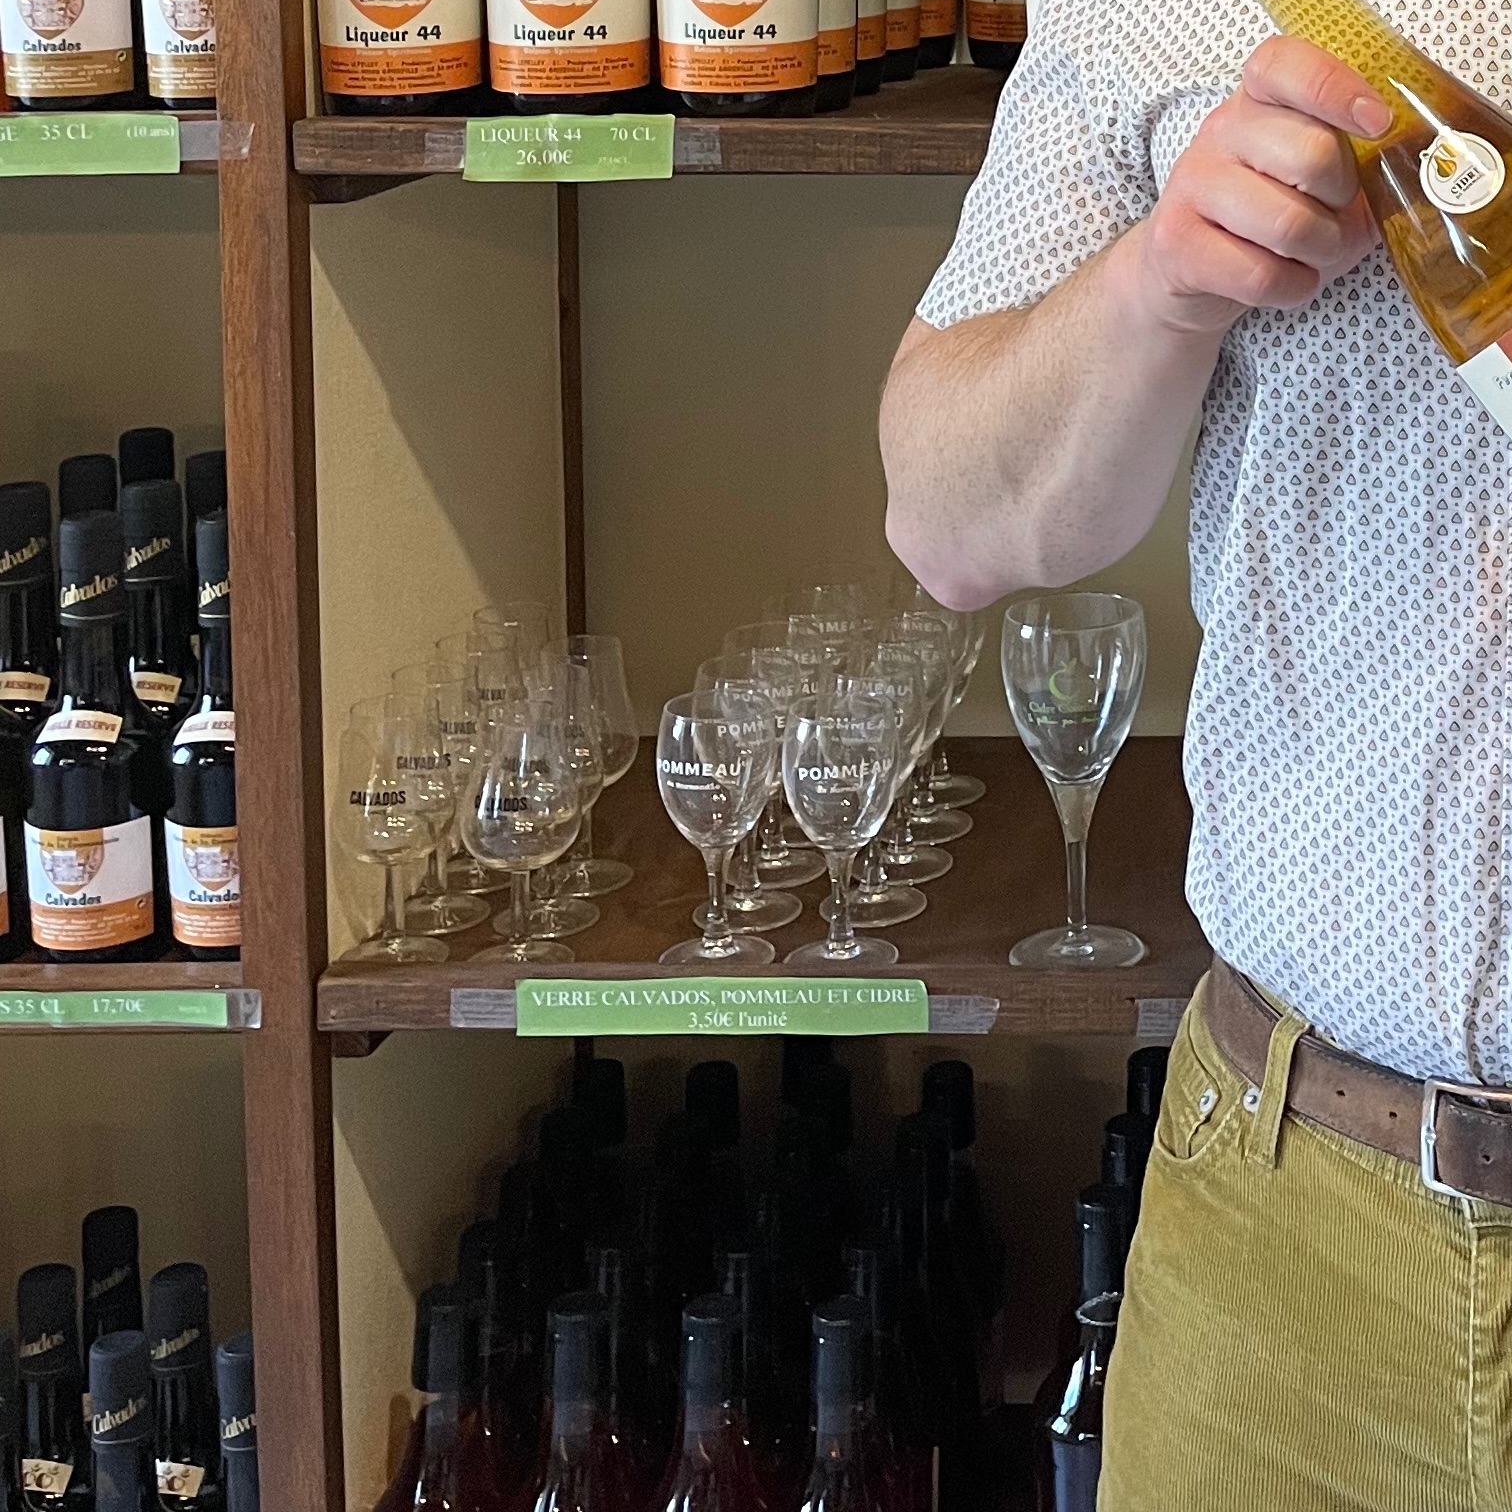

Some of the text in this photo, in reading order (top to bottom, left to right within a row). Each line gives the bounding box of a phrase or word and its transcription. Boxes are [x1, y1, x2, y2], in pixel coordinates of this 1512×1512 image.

[345, 25, 442, 47] Liqueur 44
[513, 24, 608, 46] Liqueur 44
[684, 23, 778, 45] Liqueur 44
[23, 39, 82, 53] Calvados
[165, 40, 216, 54] Calvado
[41, 125, 61, 141] 35
[66, 123, 93, 140] CL
[481, 127, 656, 143] LIQUEUR 44 70 CL
[516, 150, 573, 167] 26,00€
[656, 758, 741, 777] POMMEAU
[798, 758, 892, 781] POMMEAU
[350, 790, 406, 806] CALVADOS
[45, 893, 101, 906] Calvados
[189, 890, 239, 903] Calvado
[532, 988, 917, 1007] VERRE CALVADOS, POMMEAU ET CIDRE
[15, 1000, 34, 1015] 35
[41, 999, 65, 1014] CL
[93, 999, 145, 1014] 17,70€
[688, 1010, 788, 1028] 3,50€ l'unité
